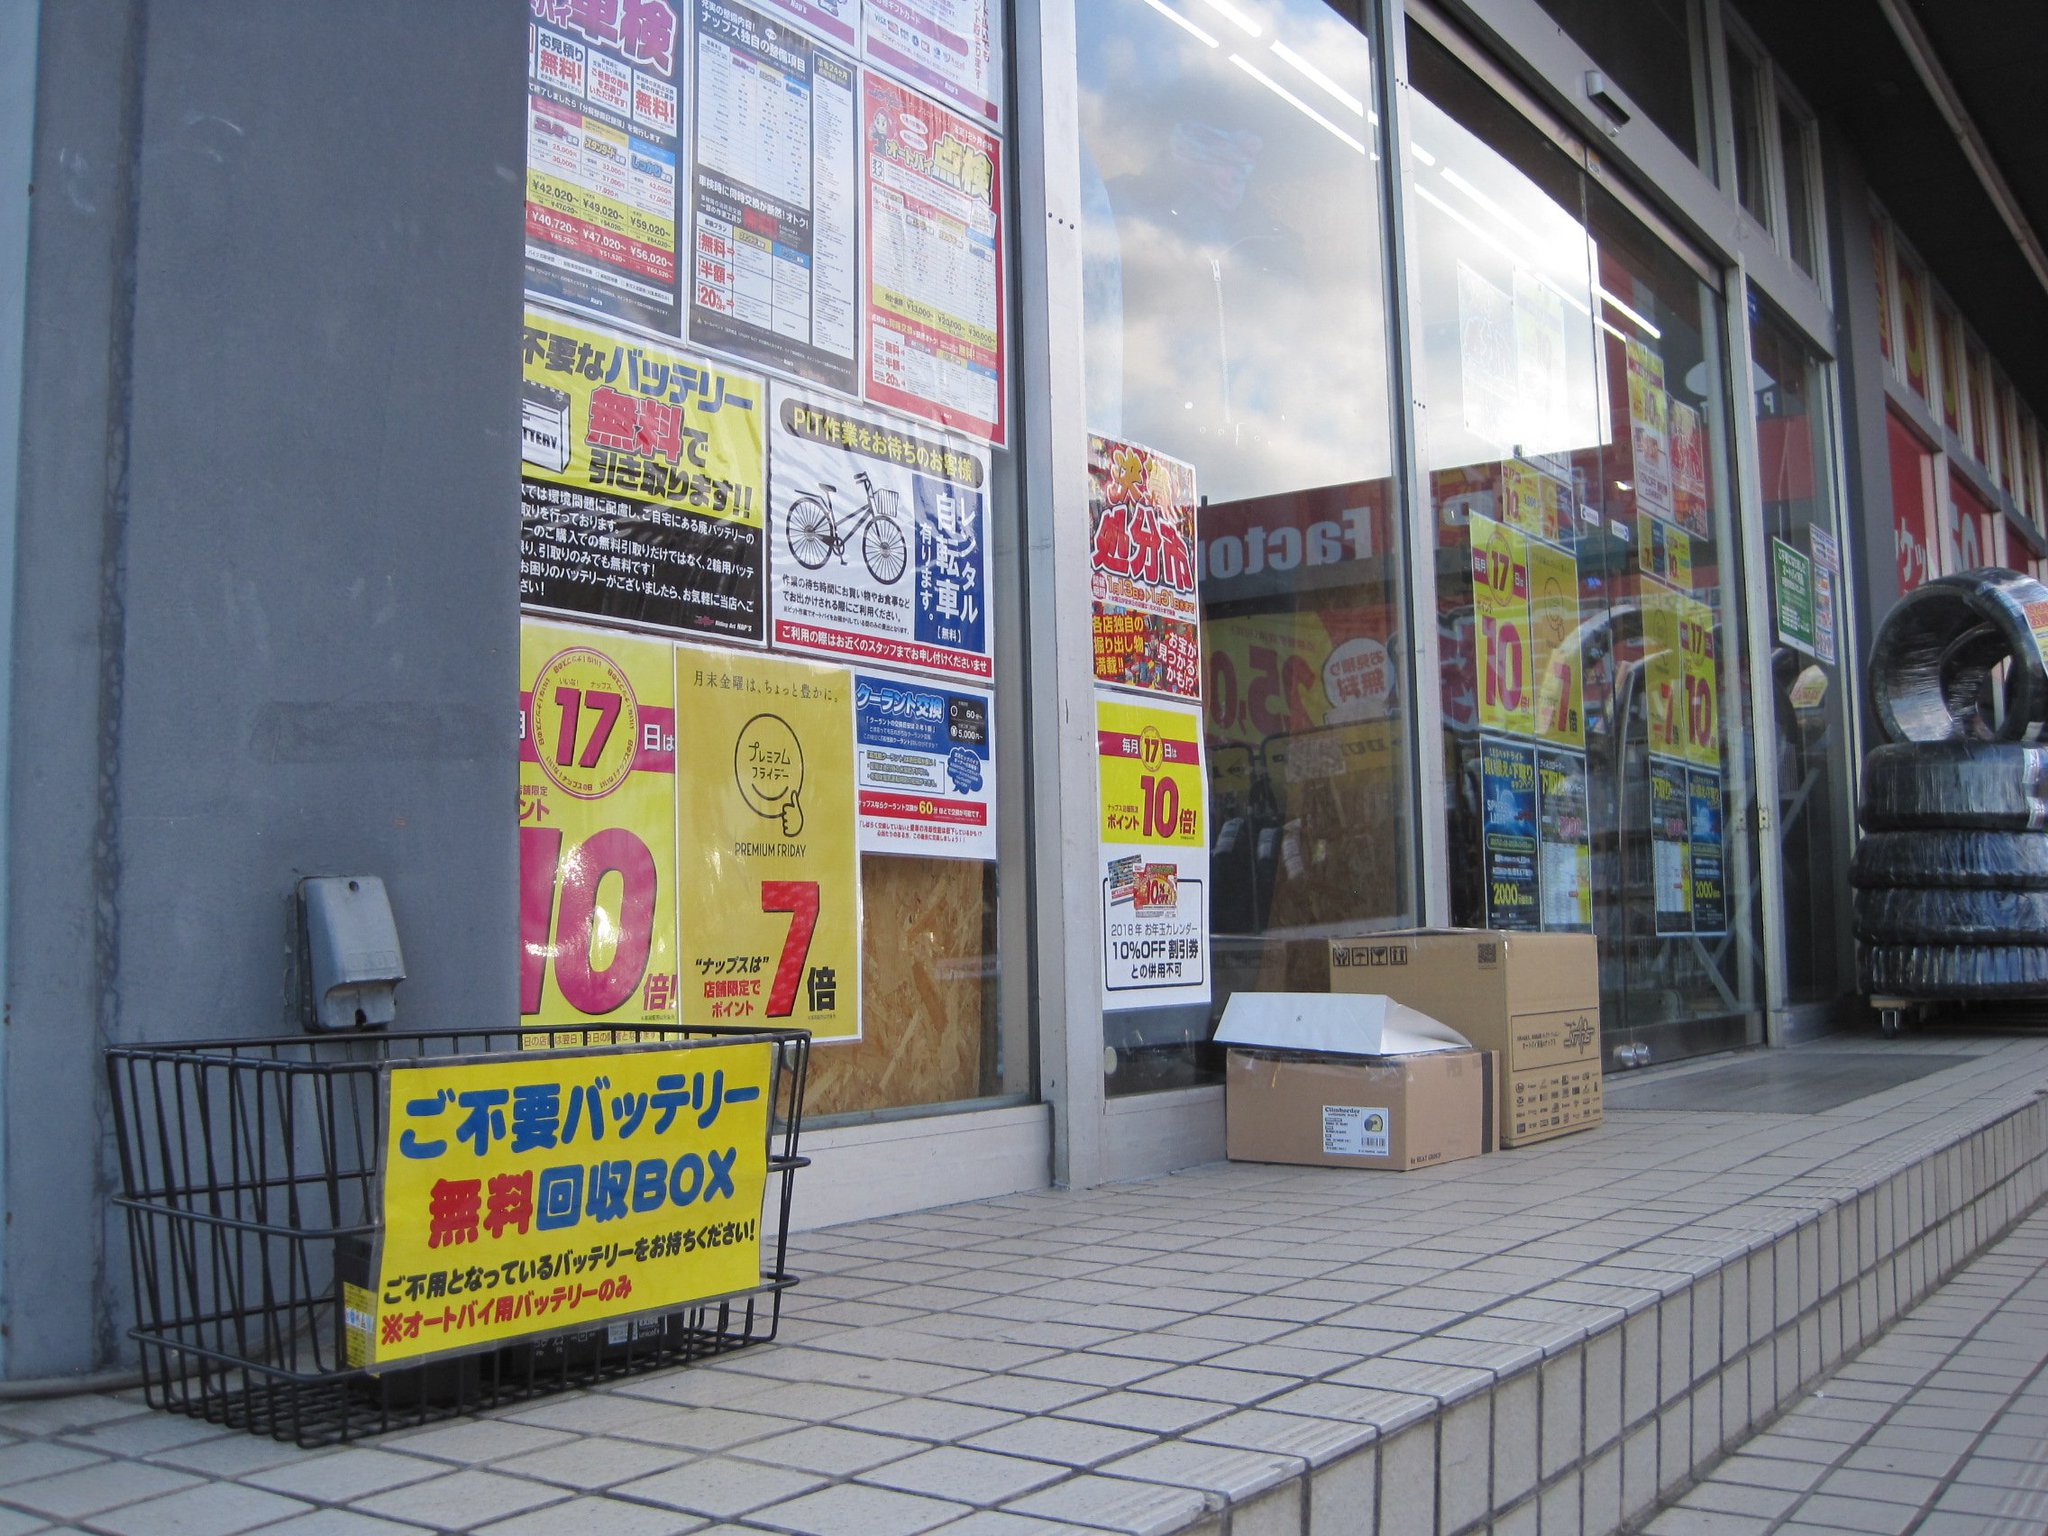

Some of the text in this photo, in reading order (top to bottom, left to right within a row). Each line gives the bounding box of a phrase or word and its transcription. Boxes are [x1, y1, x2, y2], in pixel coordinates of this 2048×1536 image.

[539, 32, 584, 62] お見積り
[702, 10, 806, 72] ナップス独自の整備項目
[540, 49, 582, 87] 無料!
[635, 90, 676, 125] 無料!
[886, 140, 935, 178] オートバイ
[932, 132, 994, 207] 点検
[701, 233, 726, 259] 無料
[701, 260, 726, 284] 半額
[586, 385, 709, 468] 無料で
[793, 407, 973, 483] PIT作業をお待ちのお客様
[588, 449, 753, 519] 引き取ります!!
[935, 492, 960, 620] 自転車
[960, 496, 979, 625] レンタル
[1091, 504, 1195, 593] 処分市
[919, 523, 935, 621] 有ります。
[1491, 550, 1510, 591] 17
[782, 573, 910, 610] 作業の待ち時間にお買い物やお食事など
[782, 590, 901, 622] でお出かけされる際にご利用ください。
[1093, 615, 1144, 633] 各店独自の
[782, 625, 987, 673] ご利用の際はお近くのスタッフまでお申し付けくださいませ
[1094, 635, 1144, 654] 掘り出し物
[1158, 643, 1195, 676] 見つかる
[1168, 632, 1197, 659] お宝が
[1482, 615, 1522, 711] 10
[1096, 656, 1124, 675] 満載!!
[694, 670, 838, 703] 月末金曜は、ちょっと豊かに。
[857, 683, 945, 723] クーラント交換
[1553, 662, 1571, 732] 7
[554, 686, 623, 768] 17
[644, 723, 675, 751] 日は
[1686, 673, 1711, 747] 10
[748, 742, 790, 765] プレミアム
[1122, 737, 1139, 754] 毎月
[1144, 738, 1160, 763] 17
[752, 766, 789, 780] フライデー
[1107, 813, 1140, 831] ポイント
[1140, 775, 1197, 838] 10 倍!
[735, 842, 807, 857] PREMIUM FRIDAY
[1111, 922, 1197, 937] 2018年 お年玉カレンダー
[761, 880, 837, 1018] 7 倍
[1112, 938, 1199, 960] 10%OFF 割引券
[704, 979, 761, 998] 店舗限定で
[1131, 962, 1182, 979] との併用不可
[712, 1000, 754, 1018] ポイント
[399, 1069, 761, 1159] ご不要バッテリー
[428, 1146, 738, 1250] 無料回収BOX
[383, 1217, 755, 1305] ご不用となっているバッテリーをお持ちください!
[381, 1274, 633, 1346] ※オートバイ用バッテリーのみ
